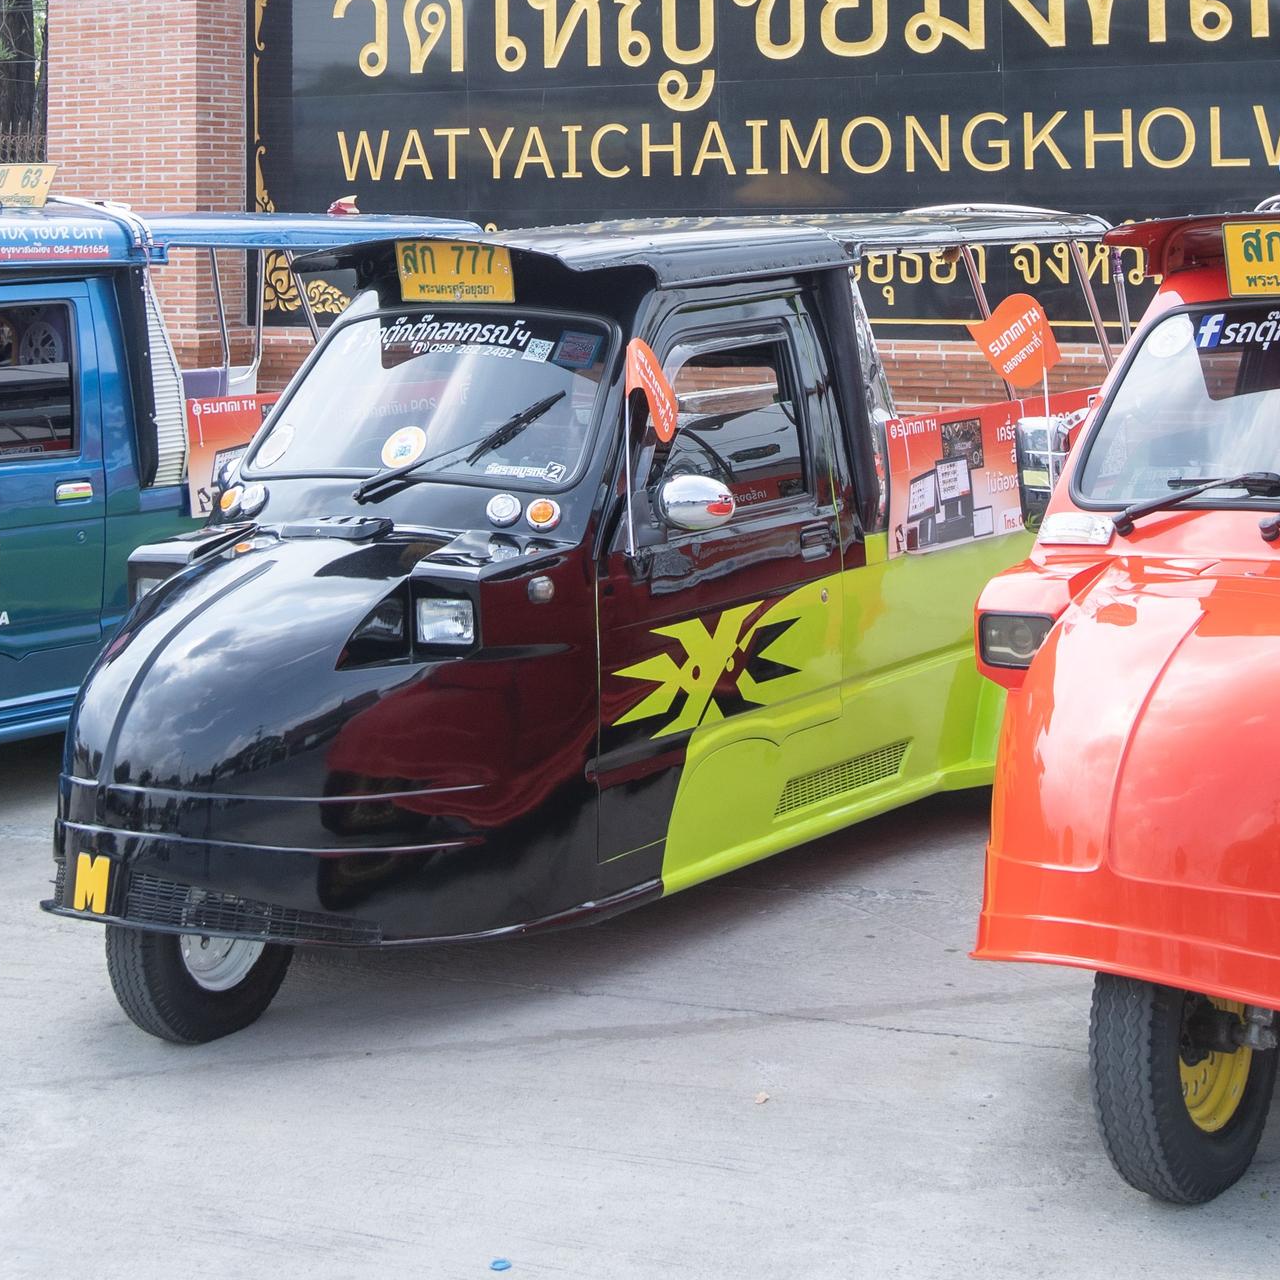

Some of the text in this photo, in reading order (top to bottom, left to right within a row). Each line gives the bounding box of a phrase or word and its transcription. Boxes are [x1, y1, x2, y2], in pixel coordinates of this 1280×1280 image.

[21, 168, 43, 189] 63
[30, 227, 70, 240] TOUR
[72, 226, 104, 240] CITY
[402, 243, 496, 275] สก 777
[988, 306, 1041, 358] SUNMI TH
[429, 344, 516, 359] 098 282 2482
[203, 400, 257, 414] SUNMI TH
[897, 419, 937, 437] SUNMI TH
